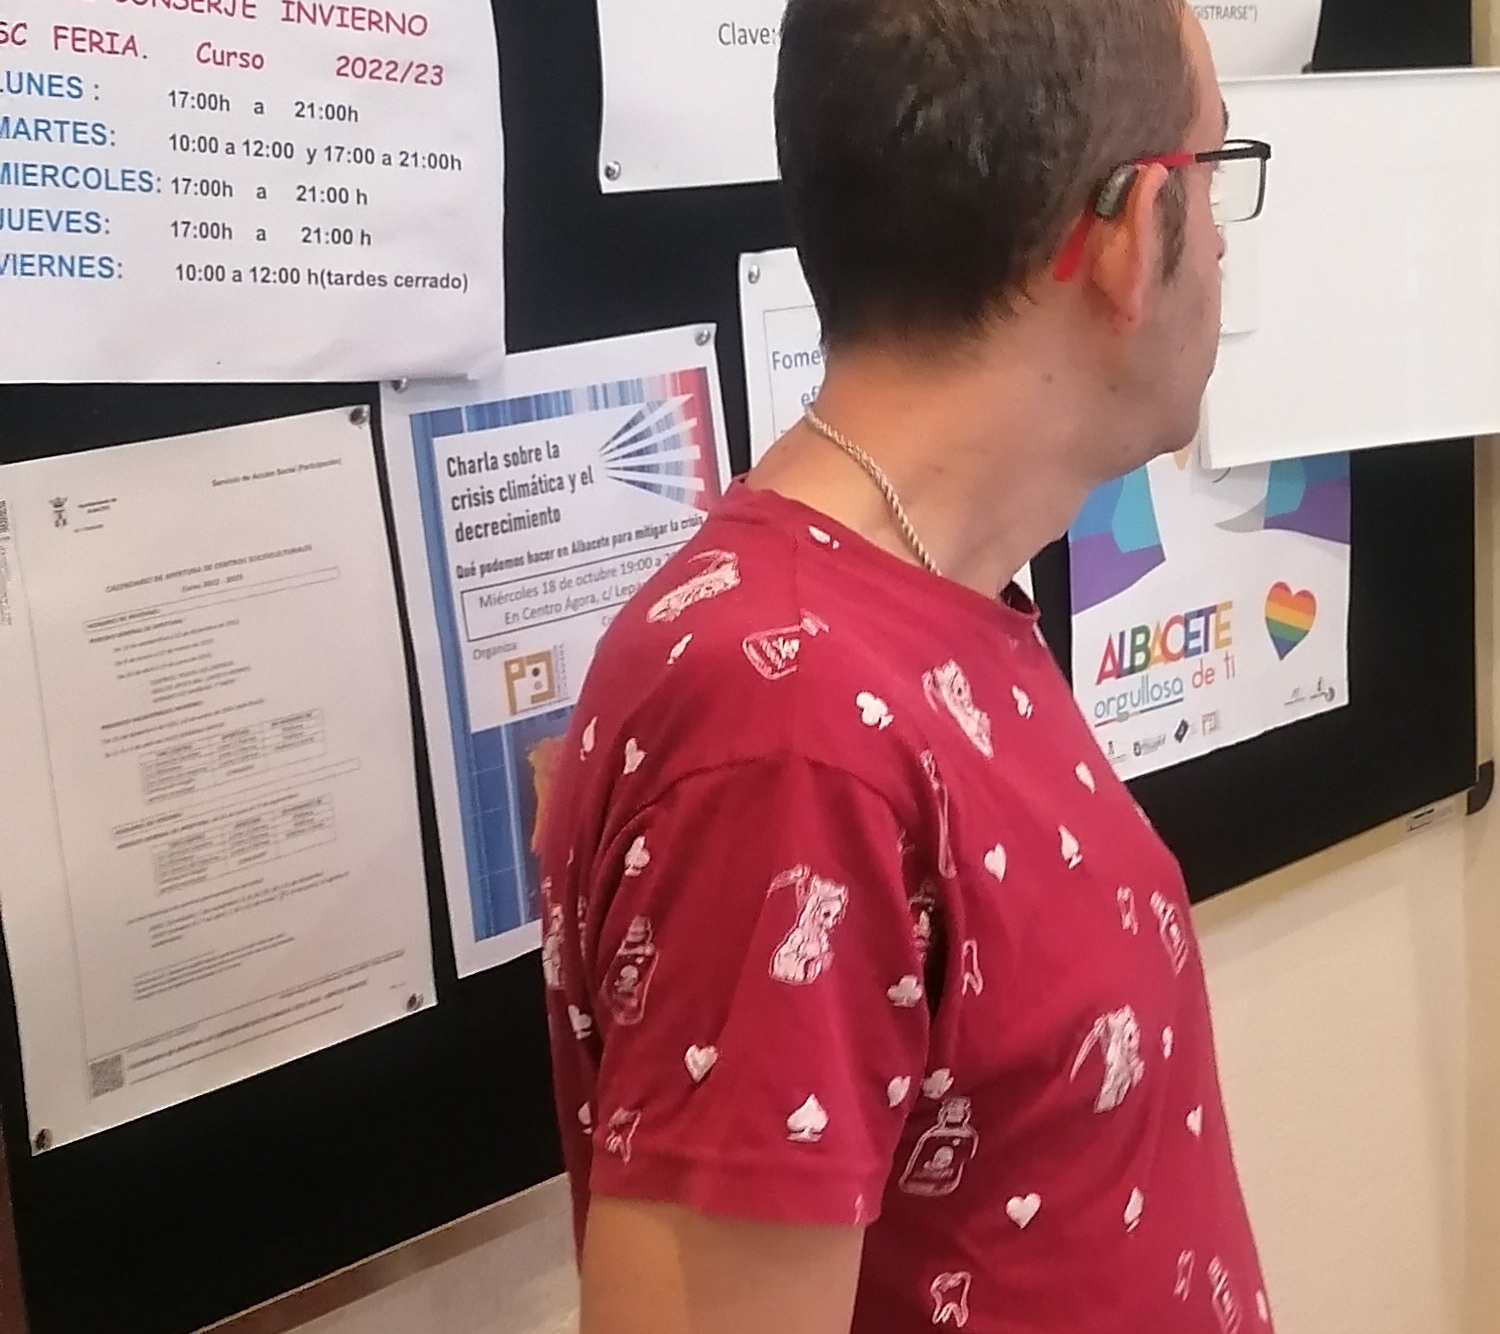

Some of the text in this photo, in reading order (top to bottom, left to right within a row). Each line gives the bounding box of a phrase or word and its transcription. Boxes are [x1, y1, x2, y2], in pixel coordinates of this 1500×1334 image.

[280, 0, 428, 38] INVIERNO
[718, 22, 776, 46] Clave:
[53, 25, 147, 59] FERIA.
[196, 42, 265, 70] Curso
[335, 55, 444, 87] 2022/23
[0, 70, 84, 100] UNES
[168, 89, 230, 112] 17:00h
[253, 101, 265, 115] a
[294, 101, 359, 122] 21:00h
[169, 134, 219, 154] 10:00
[225, 141, 235, 155] a
[242, 139, 294, 160] 12:00
[306, 146, 317, 165] y
[324, 145, 375, 165] 17:00
[382, 152, 392, 166] a
[399, 151, 462, 171] 21:00h
[171, 177, 233, 198] 17:00h
[256, 185, 267, 199] a
[296, 185, 349, 205] 21:00
[356, 187, 368, 206] h
[170, 220, 233, 240] 17:00h
[256, 228, 266, 242] a
[301, 227, 353, 246] 21:00
[360, 228, 371, 246] h
[176, 263, 226, 283] 10:00
[231, 269, 242, 283] a
[249, 266, 300, 284] 12:00
[394, 271, 469, 294] cerrado)
[772, 350, 823, 371] Fome
[446, 440, 560, 478] Charla sobre la
[451, 465, 594, 511] crisis climática y el
[455, 506, 561, 543] decrecimiento
[456, 563, 476, 579] Qué
[480, 556, 525, 578] podemos
[527, 549, 554, 566] hacer
[557, 546, 569, 558] en
[572, 537, 610, 555] Albacete
[612, 529, 632, 548] para
[635, 524, 668, 541] mitigar
[670, 519, 679, 532] la
[479, 556, 661, 609] Miércoles 18 de octubre 19:00 a
[504, 610, 518, 625] En
[522, 602, 561, 623] Centro
[564, 592, 598, 616] Ágora,
[473, 643, 517, 660] Organiza
[1095, 599, 1234, 686] ALBACETE
[1094, 650, 1236, 719] orgullosa de ti
